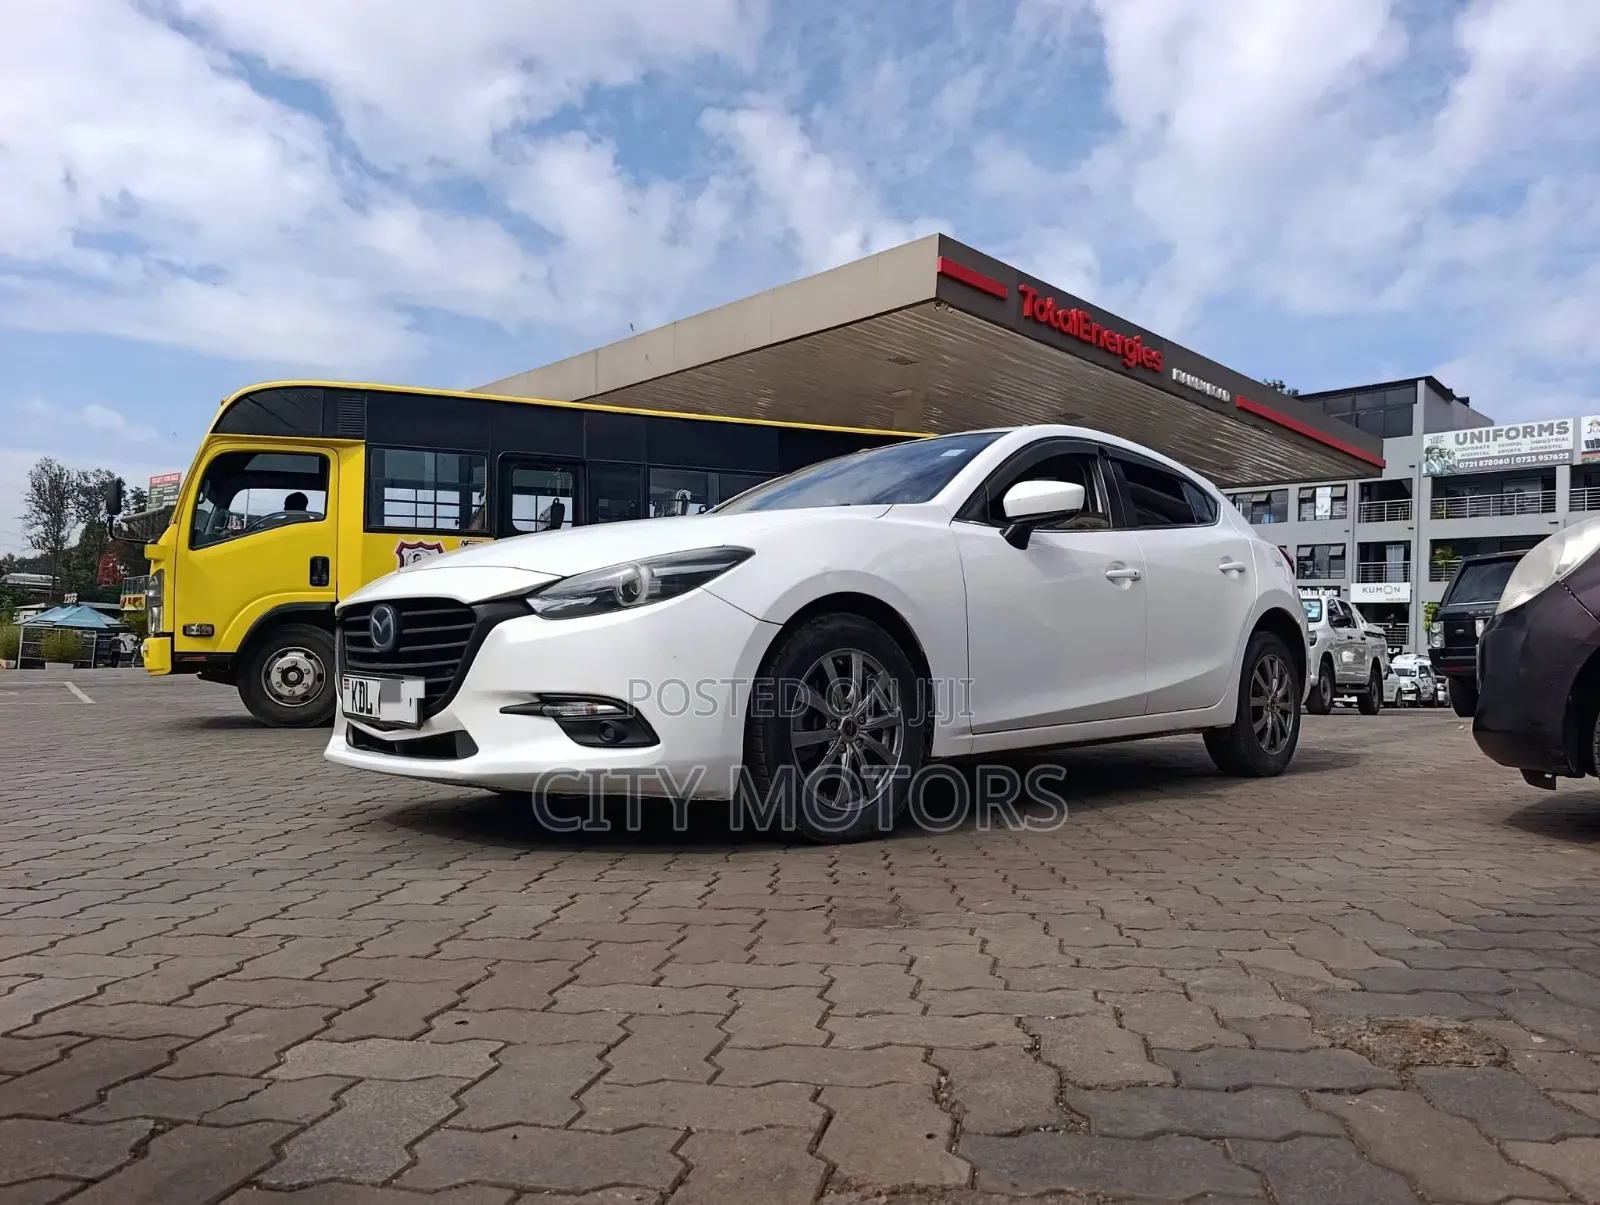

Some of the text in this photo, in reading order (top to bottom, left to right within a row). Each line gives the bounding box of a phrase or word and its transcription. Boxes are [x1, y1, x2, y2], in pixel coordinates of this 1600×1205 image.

[1018, 284, 1164, 372] TotalEnergies
[1454, 421, 1570, 446] UNIFORMS
[1454, 436, 1570, 452] CORPORATE SCHOOL INDUSTRIAL
[1529, 443, 1563, 451] DOMESTIC
[1458, 461, 1478, 469] 0721
[1537, 452, 1570, 462] 957622
[1362, 584, 1401, 595] KUMON
[351, 679, 373, 716] KDL
